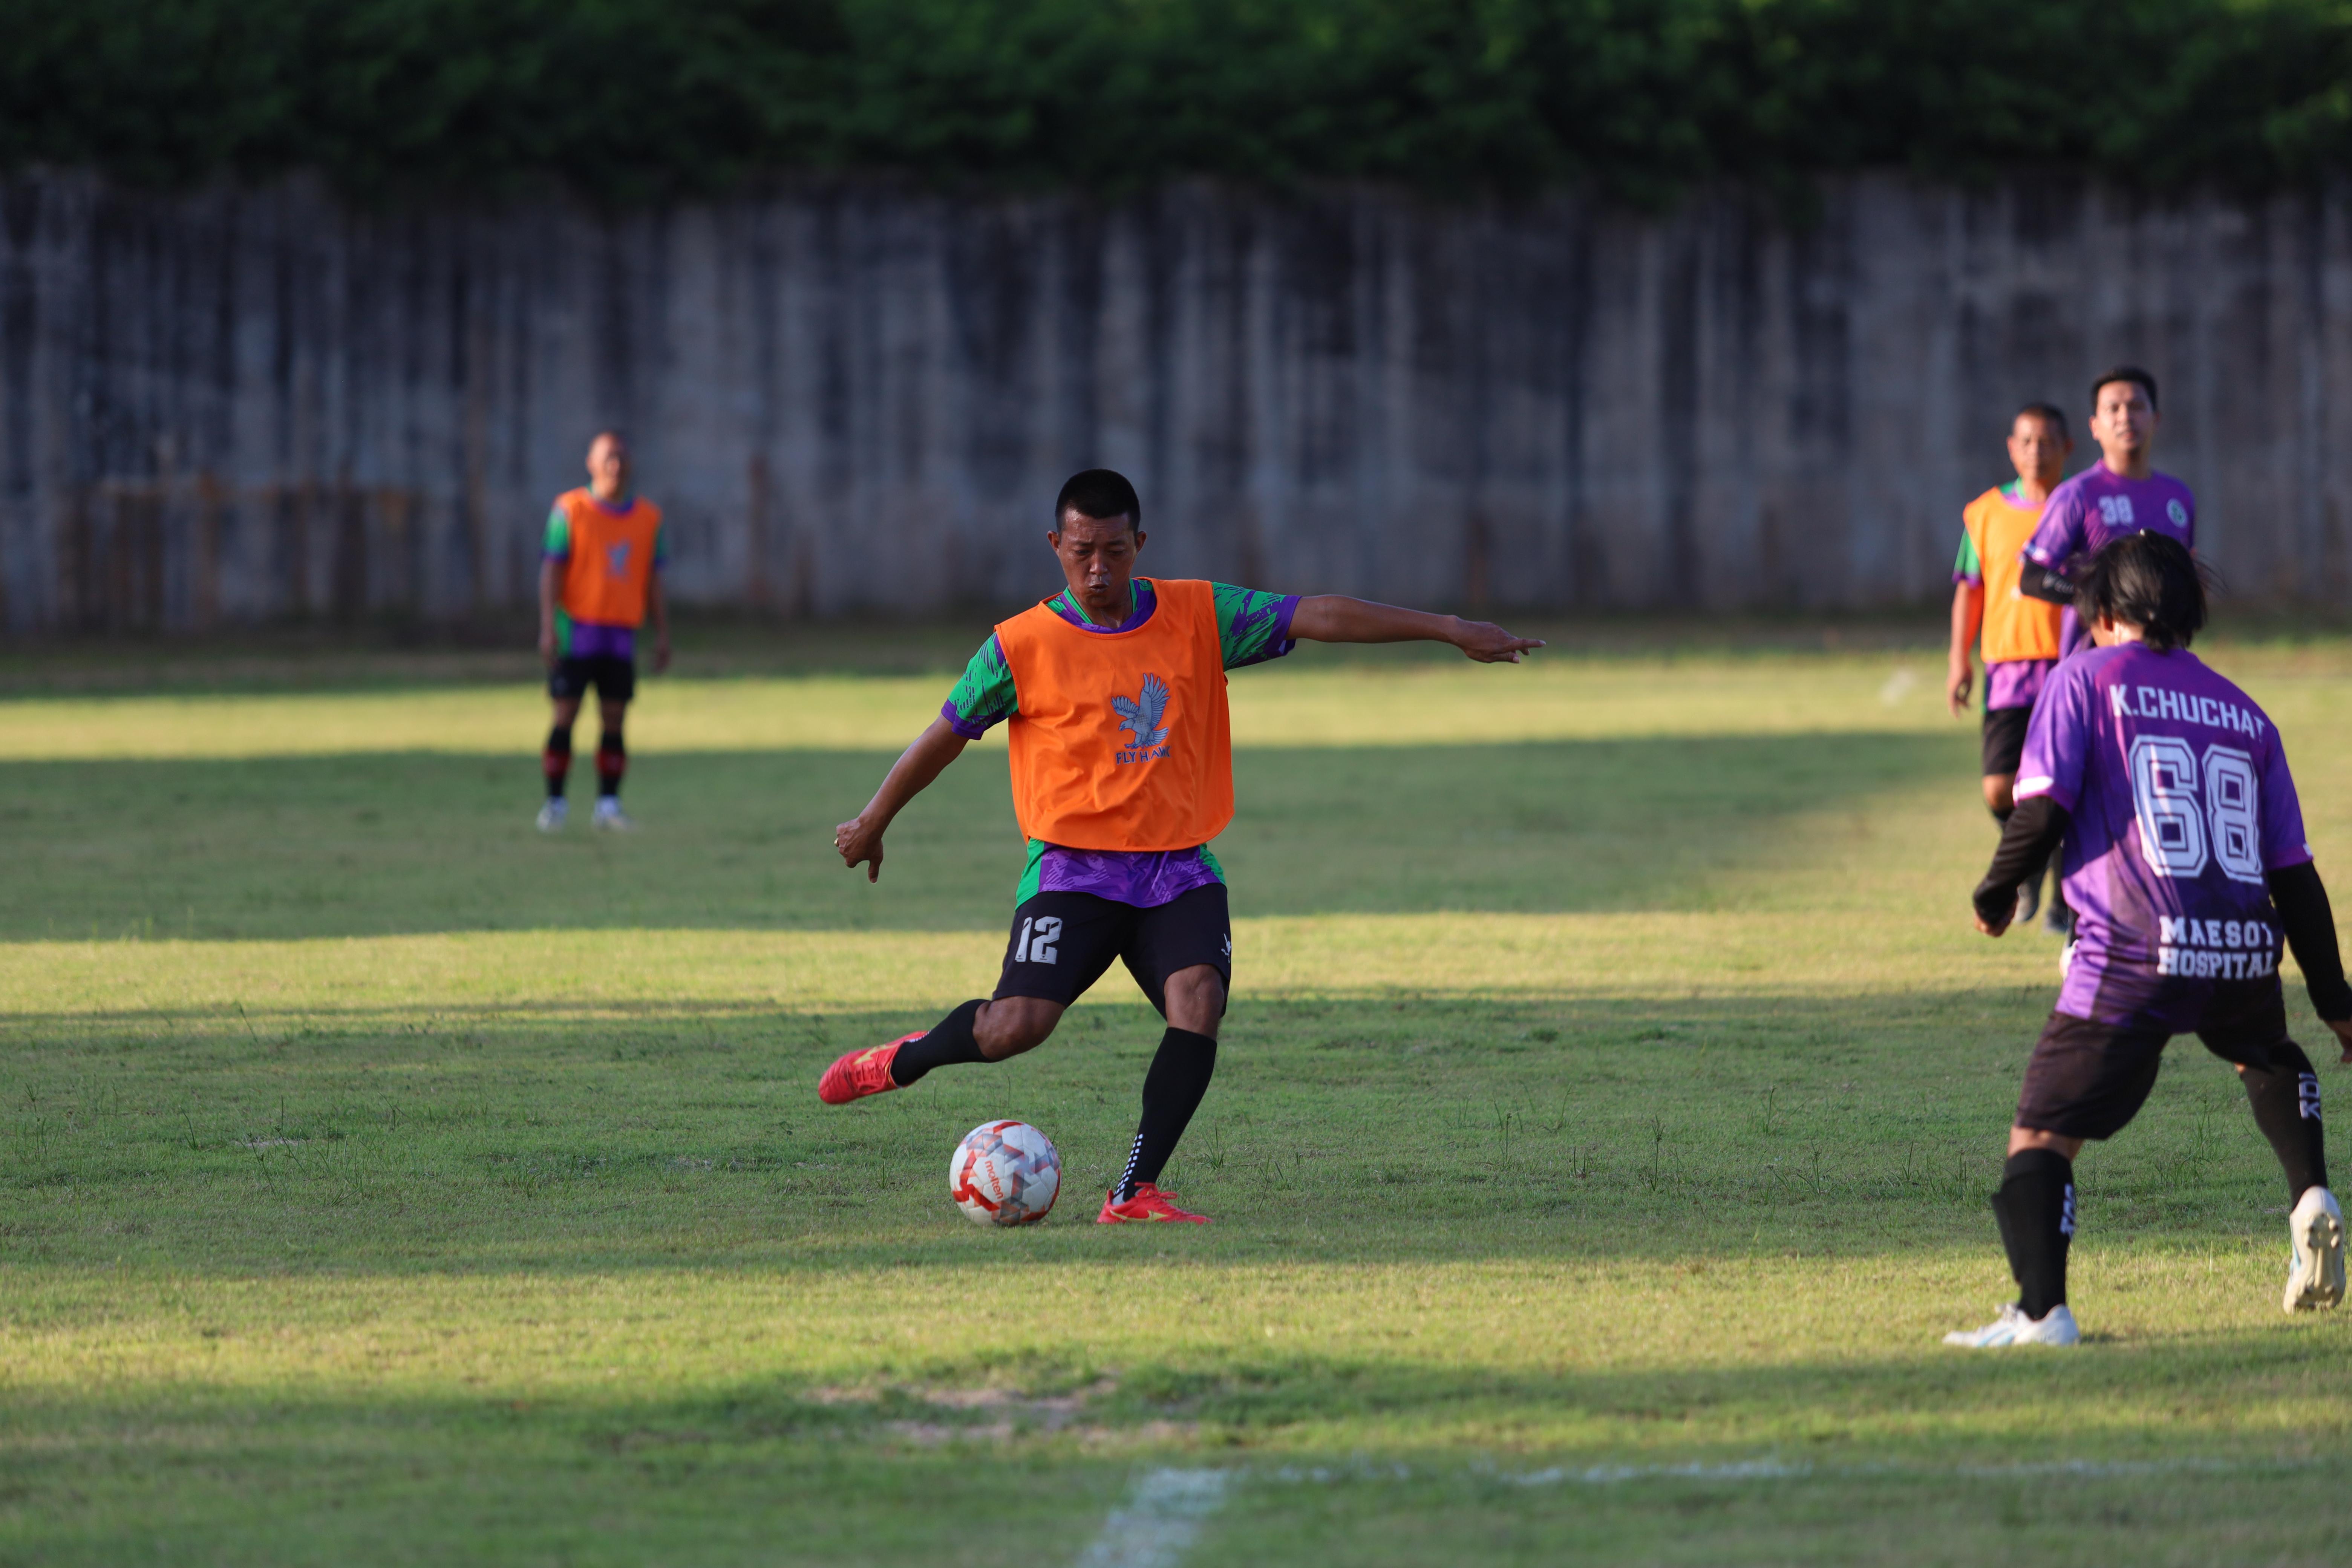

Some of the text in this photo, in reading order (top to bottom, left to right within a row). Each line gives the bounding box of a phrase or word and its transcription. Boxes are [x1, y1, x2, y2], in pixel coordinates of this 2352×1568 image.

[1116, 746, 1170, 764] FLY HAWK
[2128, 734, 2263, 885] 68
[1015, 916, 1063, 965] 12
[2156, 946, 2274, 980] HOSPITAL
[985, 1160, 1004, 1199] molten
